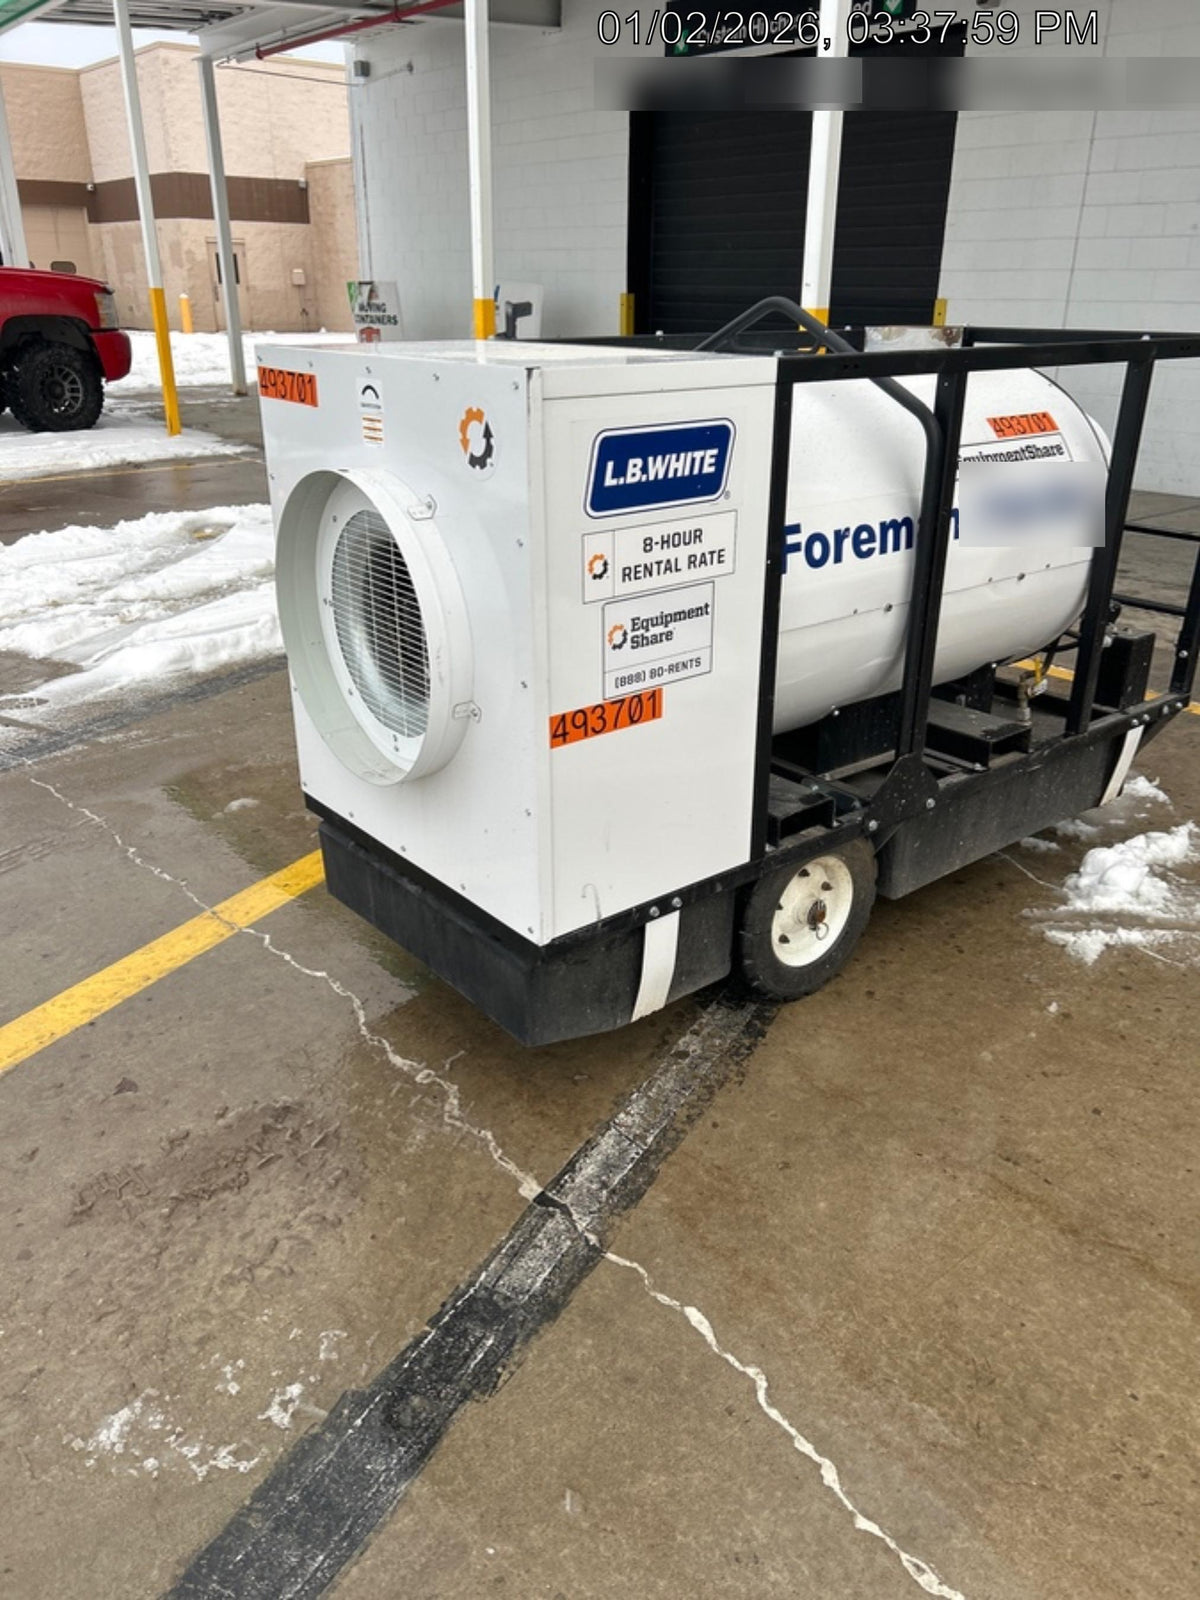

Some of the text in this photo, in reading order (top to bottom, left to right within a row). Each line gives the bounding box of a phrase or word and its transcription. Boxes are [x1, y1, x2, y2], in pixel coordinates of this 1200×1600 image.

[260, 367, 315, 404] 493701
[991, 411, 1056, 437] 493701
[603, 447, 720, 488] L.B.WHITE
[642, 527, 704, 554] 8-HOUR
[621, 548, 726, 583] RENTAL RATE
[630, 602, 711, 633] Equipment
[630, 630, 674, 650] Share
[614, 657, 702, 689] (888) 80-RENTS
[551, 689, 658, 744] 493701
